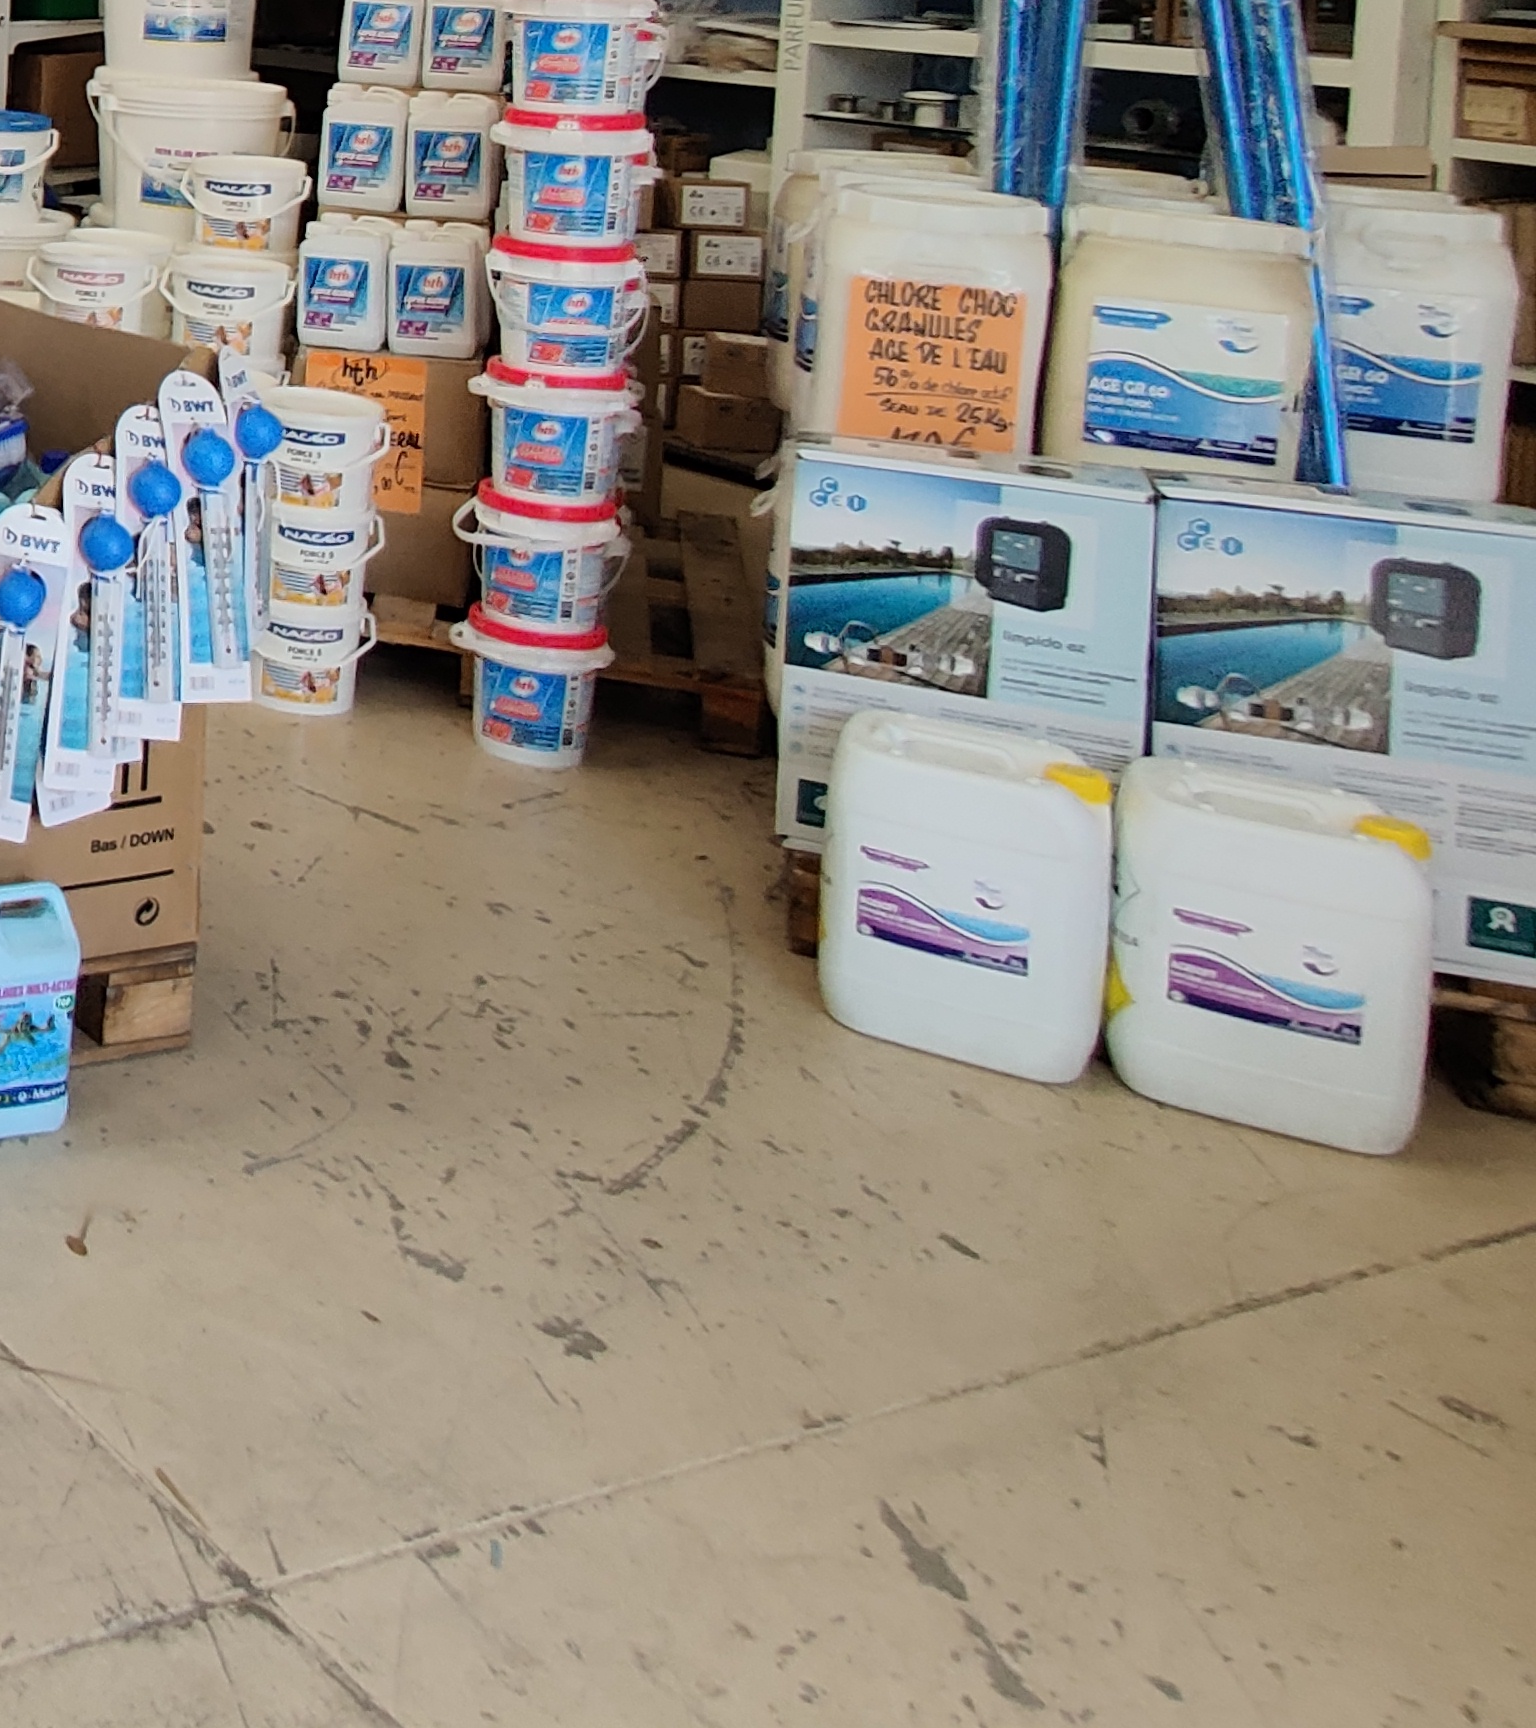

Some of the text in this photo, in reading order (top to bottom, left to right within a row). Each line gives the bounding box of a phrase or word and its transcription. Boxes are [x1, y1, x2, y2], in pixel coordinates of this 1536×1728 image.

[864, 279, 1018, 318] CHLORE CHOC
[864, 306, 983, 343] GRANULES
[868, 337, 910, 363] AGE
[914, 341, 943, 366] DE
[341, 356, 379, 386] hth
[1337, 365, 1390, 385] GR 60
[1088, 377, 1171, 398] AGE GR 60
[182, 398, 214, 413] BWT
[879, 398, 919, 415] SEAU
[141, 434, 167, 448] BW
[19, 535, 61, 554] BWT
[299, 548, 326, 559] FORCE
[286, 645, 316, 656] FORCE
[1001, 630, 1063, 652] limpido
[90, 839, 117, 853] Bas
[129, 827, 175, 847] DOWN
[32, 1083, 66, 1100] Mareva
